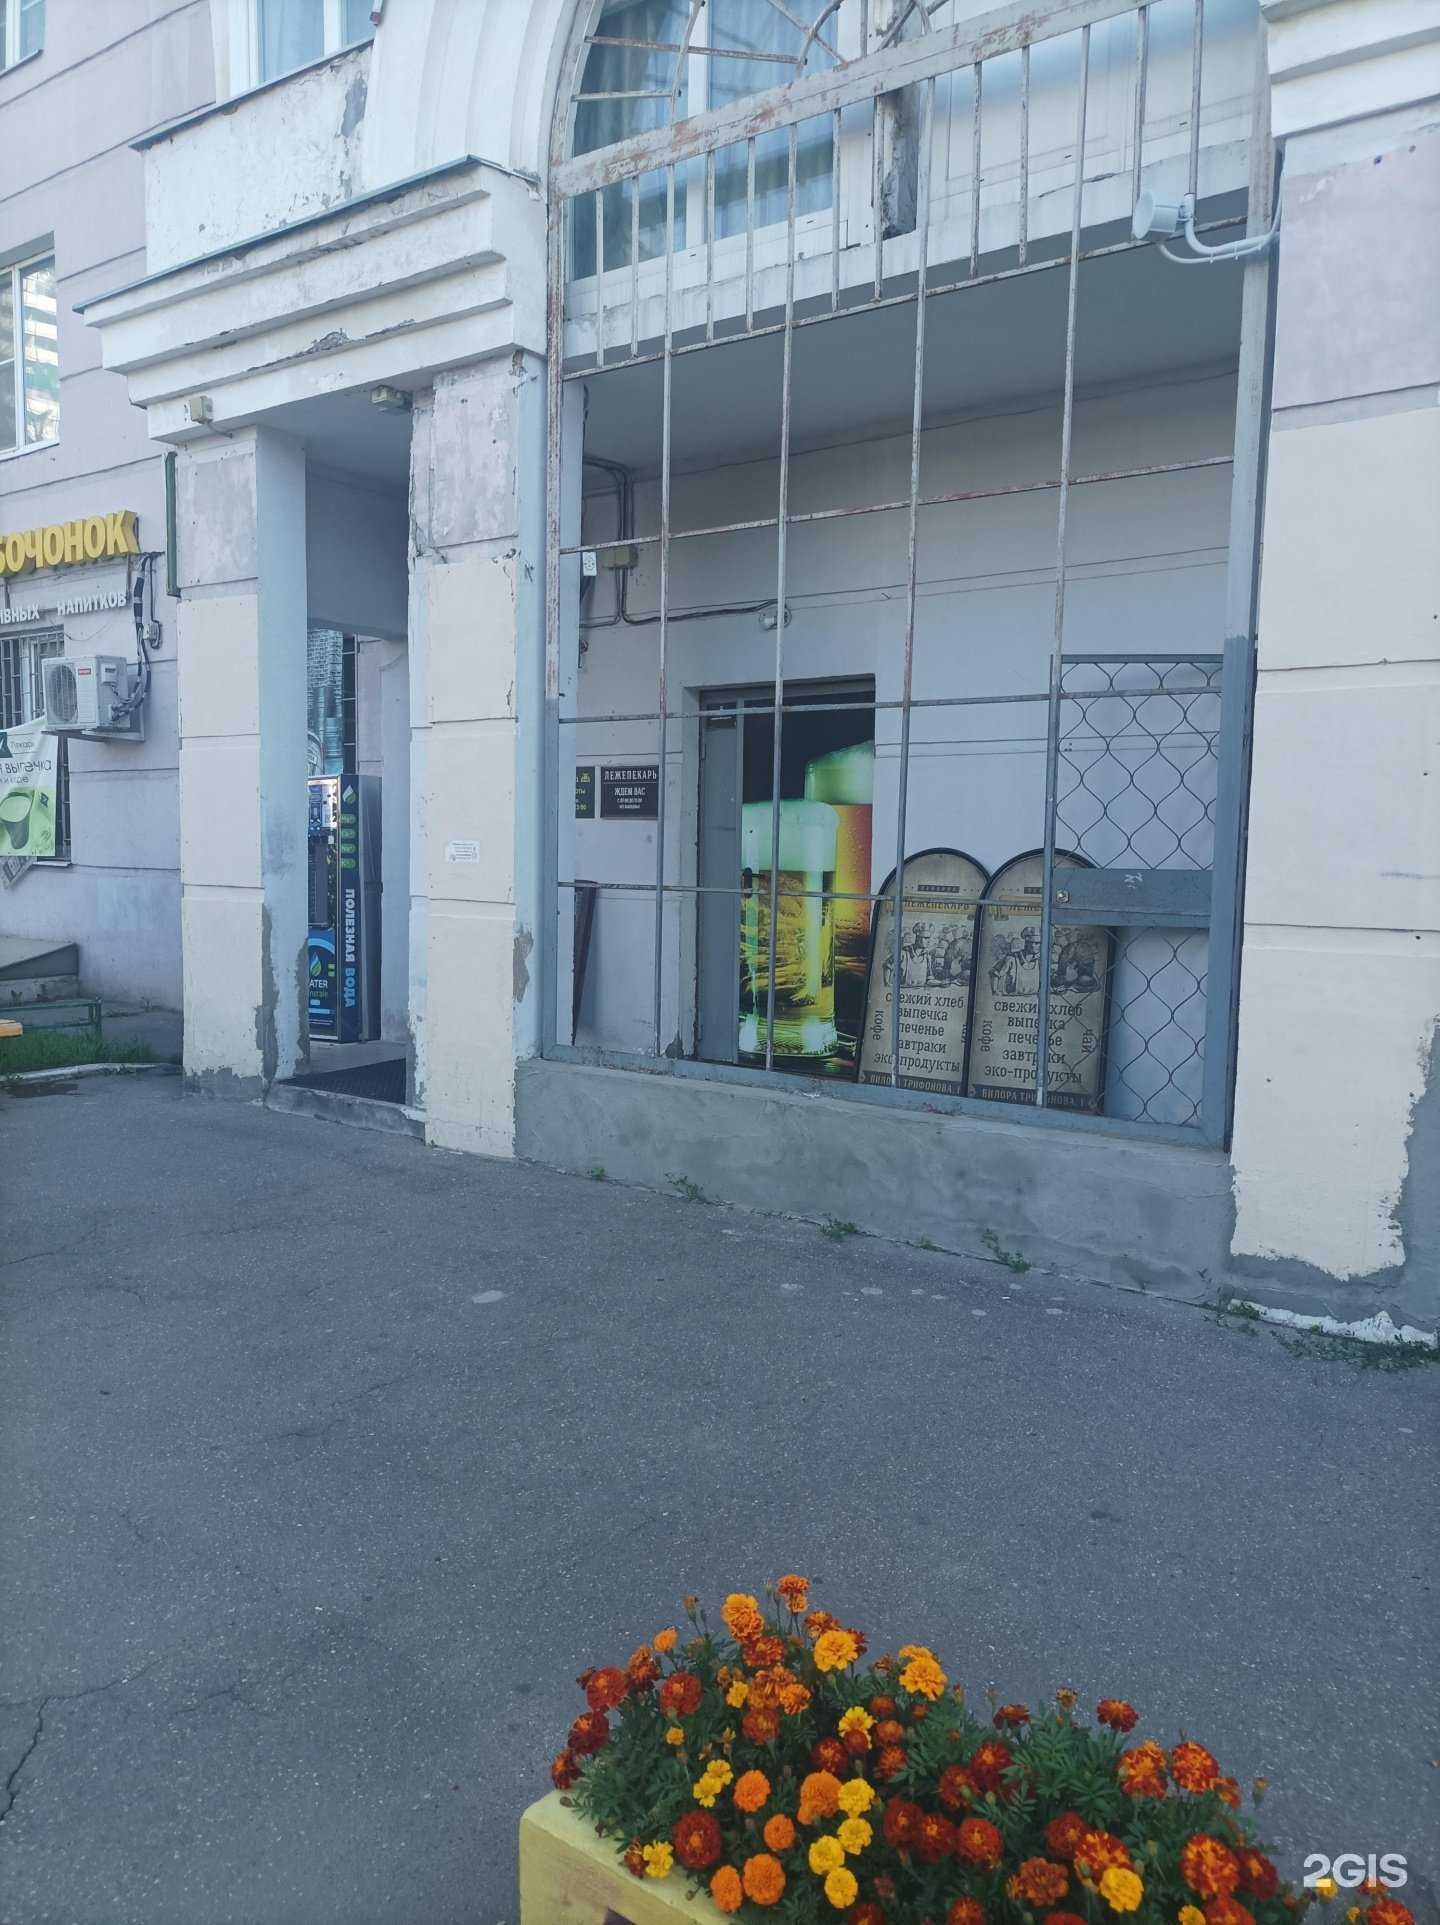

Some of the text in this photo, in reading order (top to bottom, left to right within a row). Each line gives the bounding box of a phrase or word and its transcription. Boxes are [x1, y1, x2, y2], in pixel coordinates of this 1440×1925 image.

[0, 511, 132, 573] ОЧОНОК
[57, 591, 127, 616] НАПИТКОВ
[344, 888, 356, 1008] ПОЛЕЗНАЯ ВОДА
[934, 996, 964, 1009] хлеб
[870, 1010, 885, 1041] кофе
[977, 1020, 994, 1052] кофе
